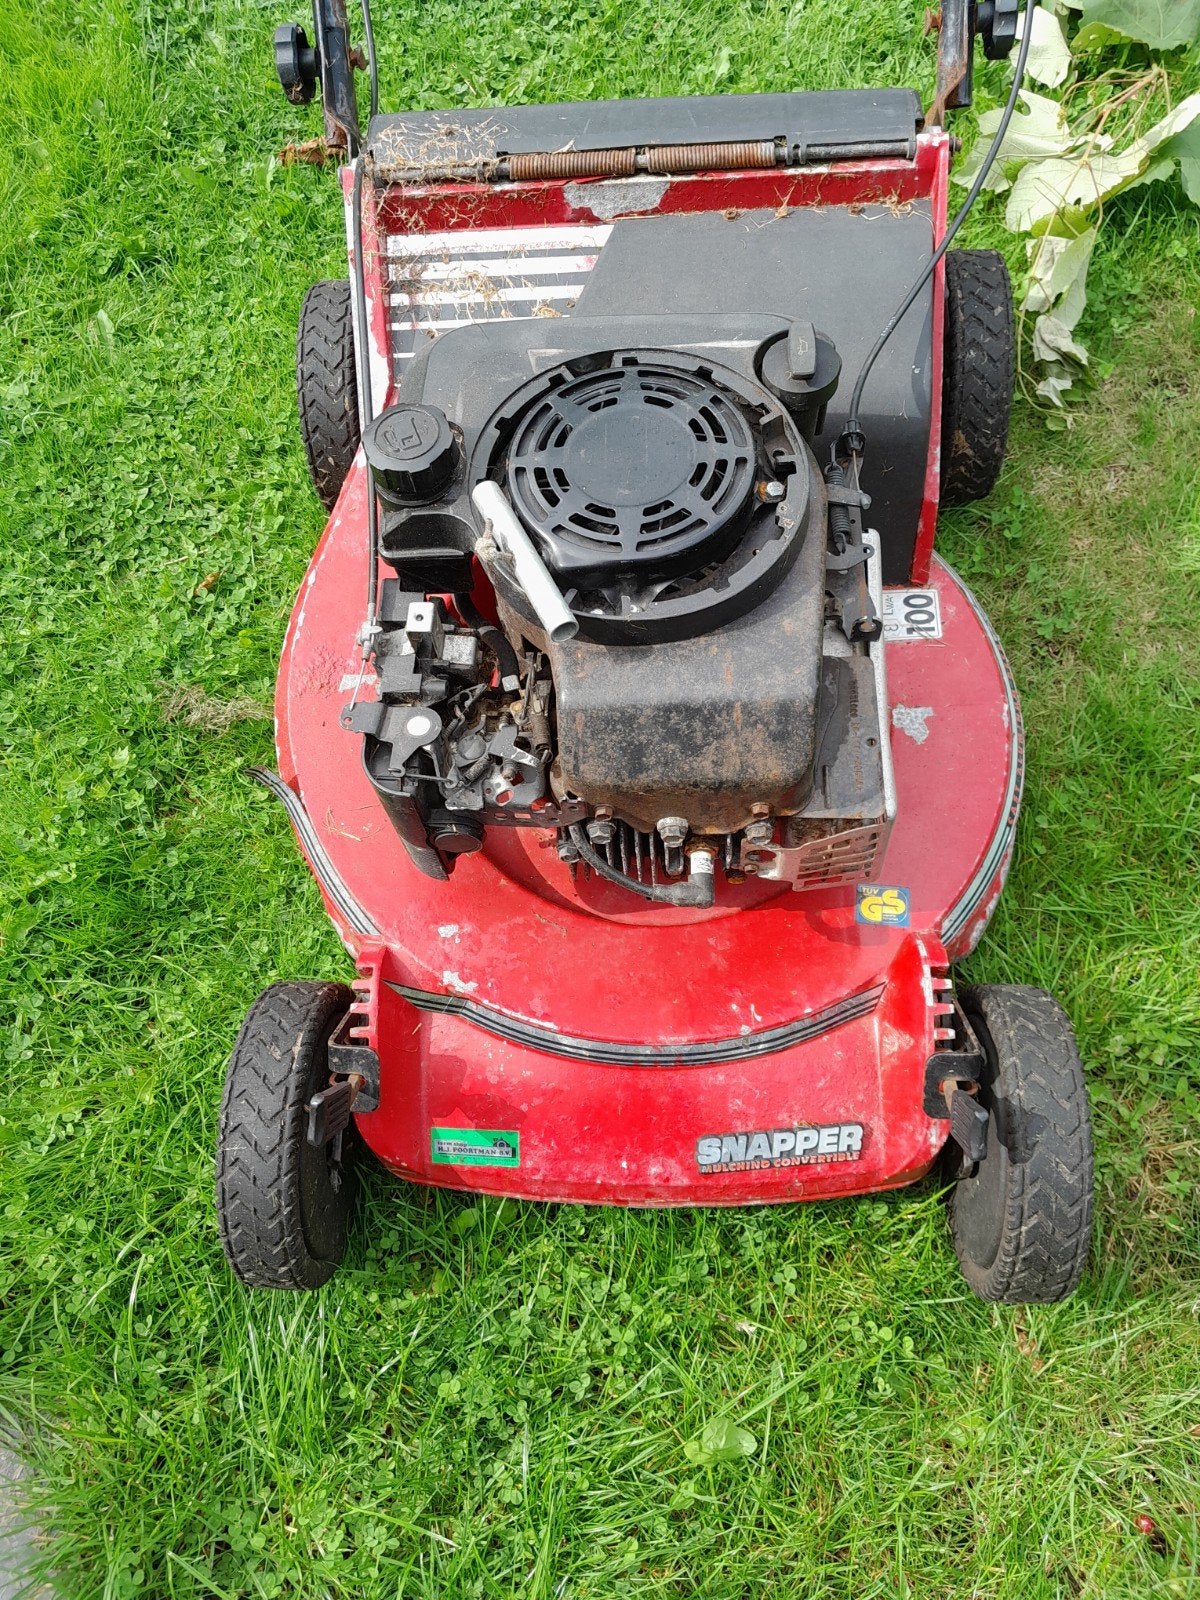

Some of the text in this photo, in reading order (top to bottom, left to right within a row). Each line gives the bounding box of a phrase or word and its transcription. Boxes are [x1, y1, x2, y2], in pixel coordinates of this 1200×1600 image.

[903, 594, 935, 635] 100
[861, 889, 906, 922] GS
[453, 1147, 497, 1156] POORTMAN
[697, 1125, 863, 1165] SNAPPER
[702, 1151, 860, 1173] MULCHING CONVERTIBLE
